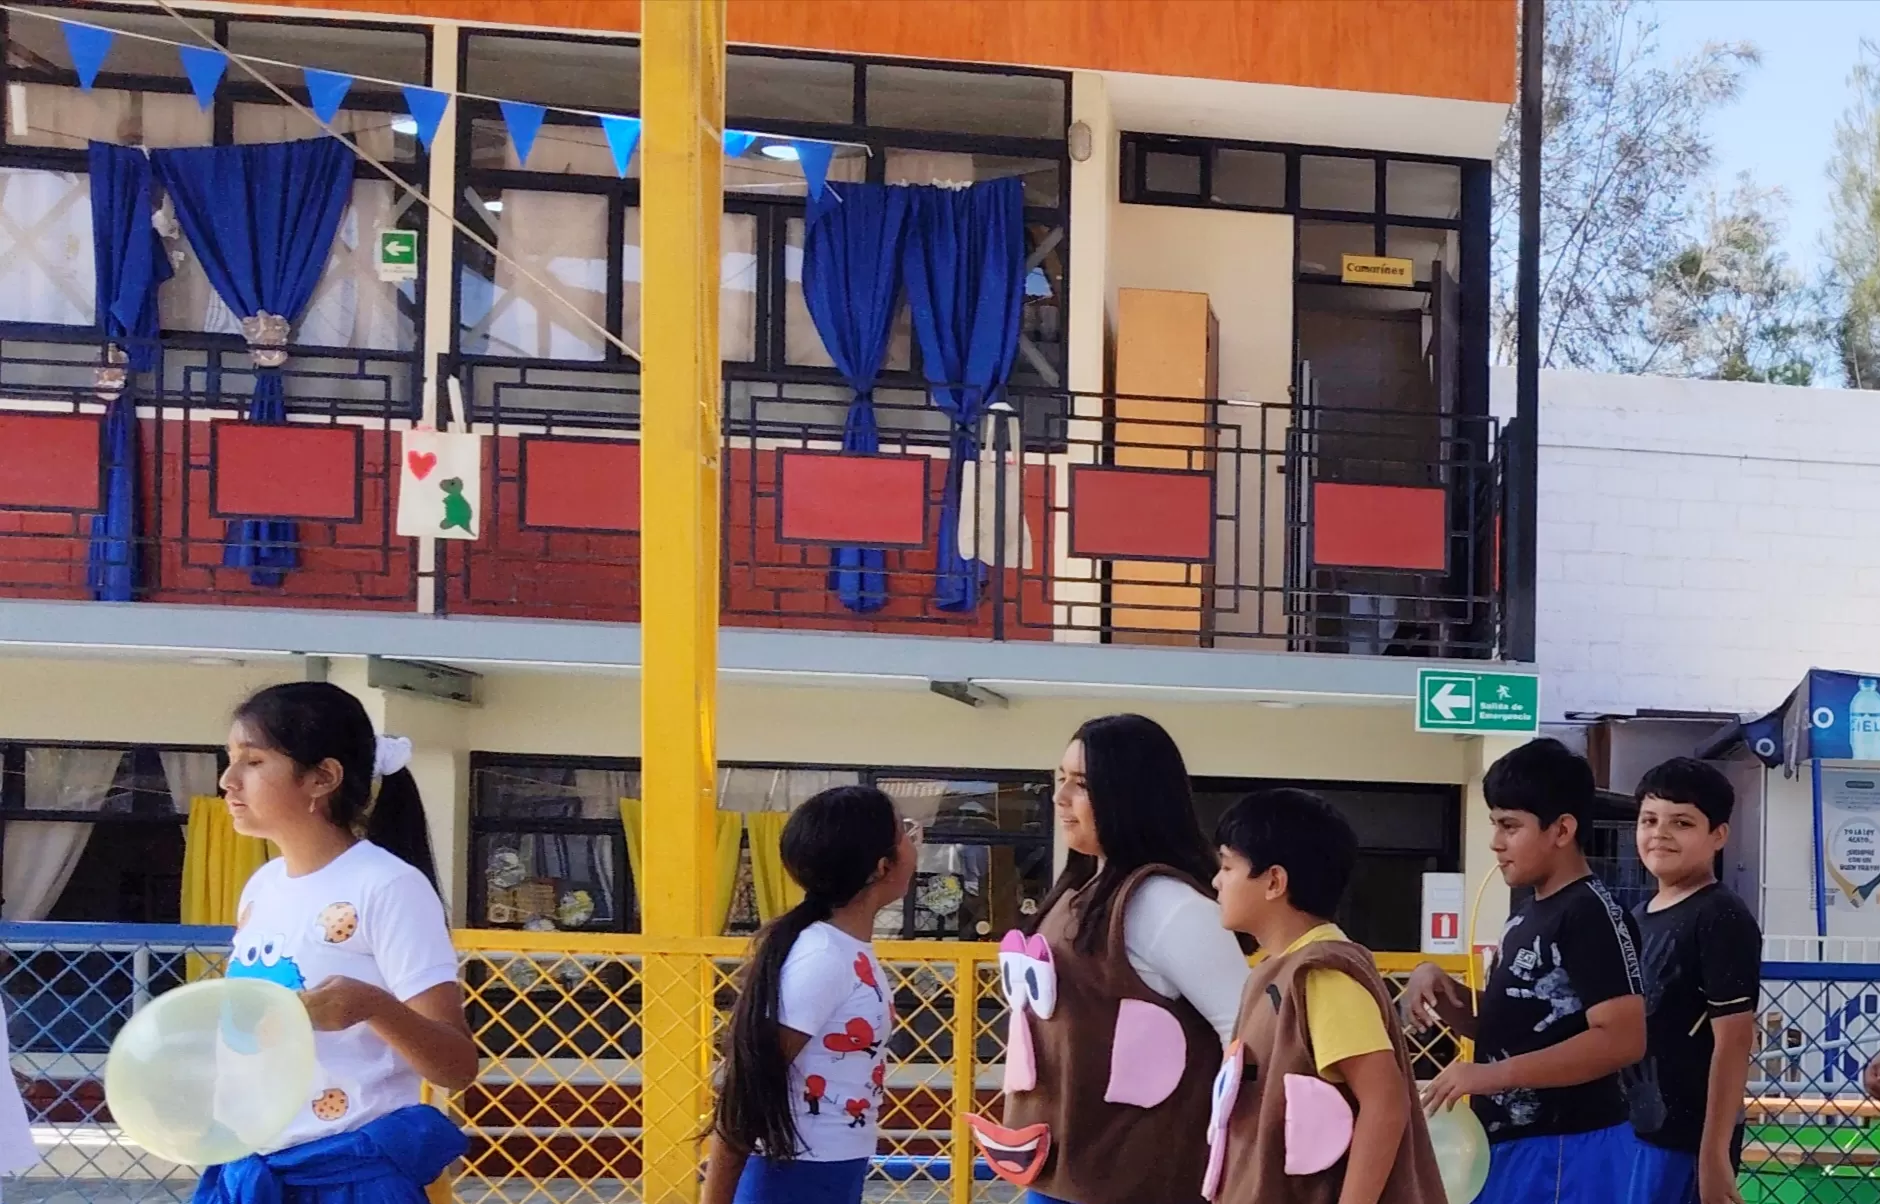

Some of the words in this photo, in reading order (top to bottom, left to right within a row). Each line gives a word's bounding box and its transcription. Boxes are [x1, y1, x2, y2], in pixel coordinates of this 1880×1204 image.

[1480, 702, 1509, 710] Salida
[1511, 703, 1523, 711] de
[1479, 711, 1531, 721] Emergencia
